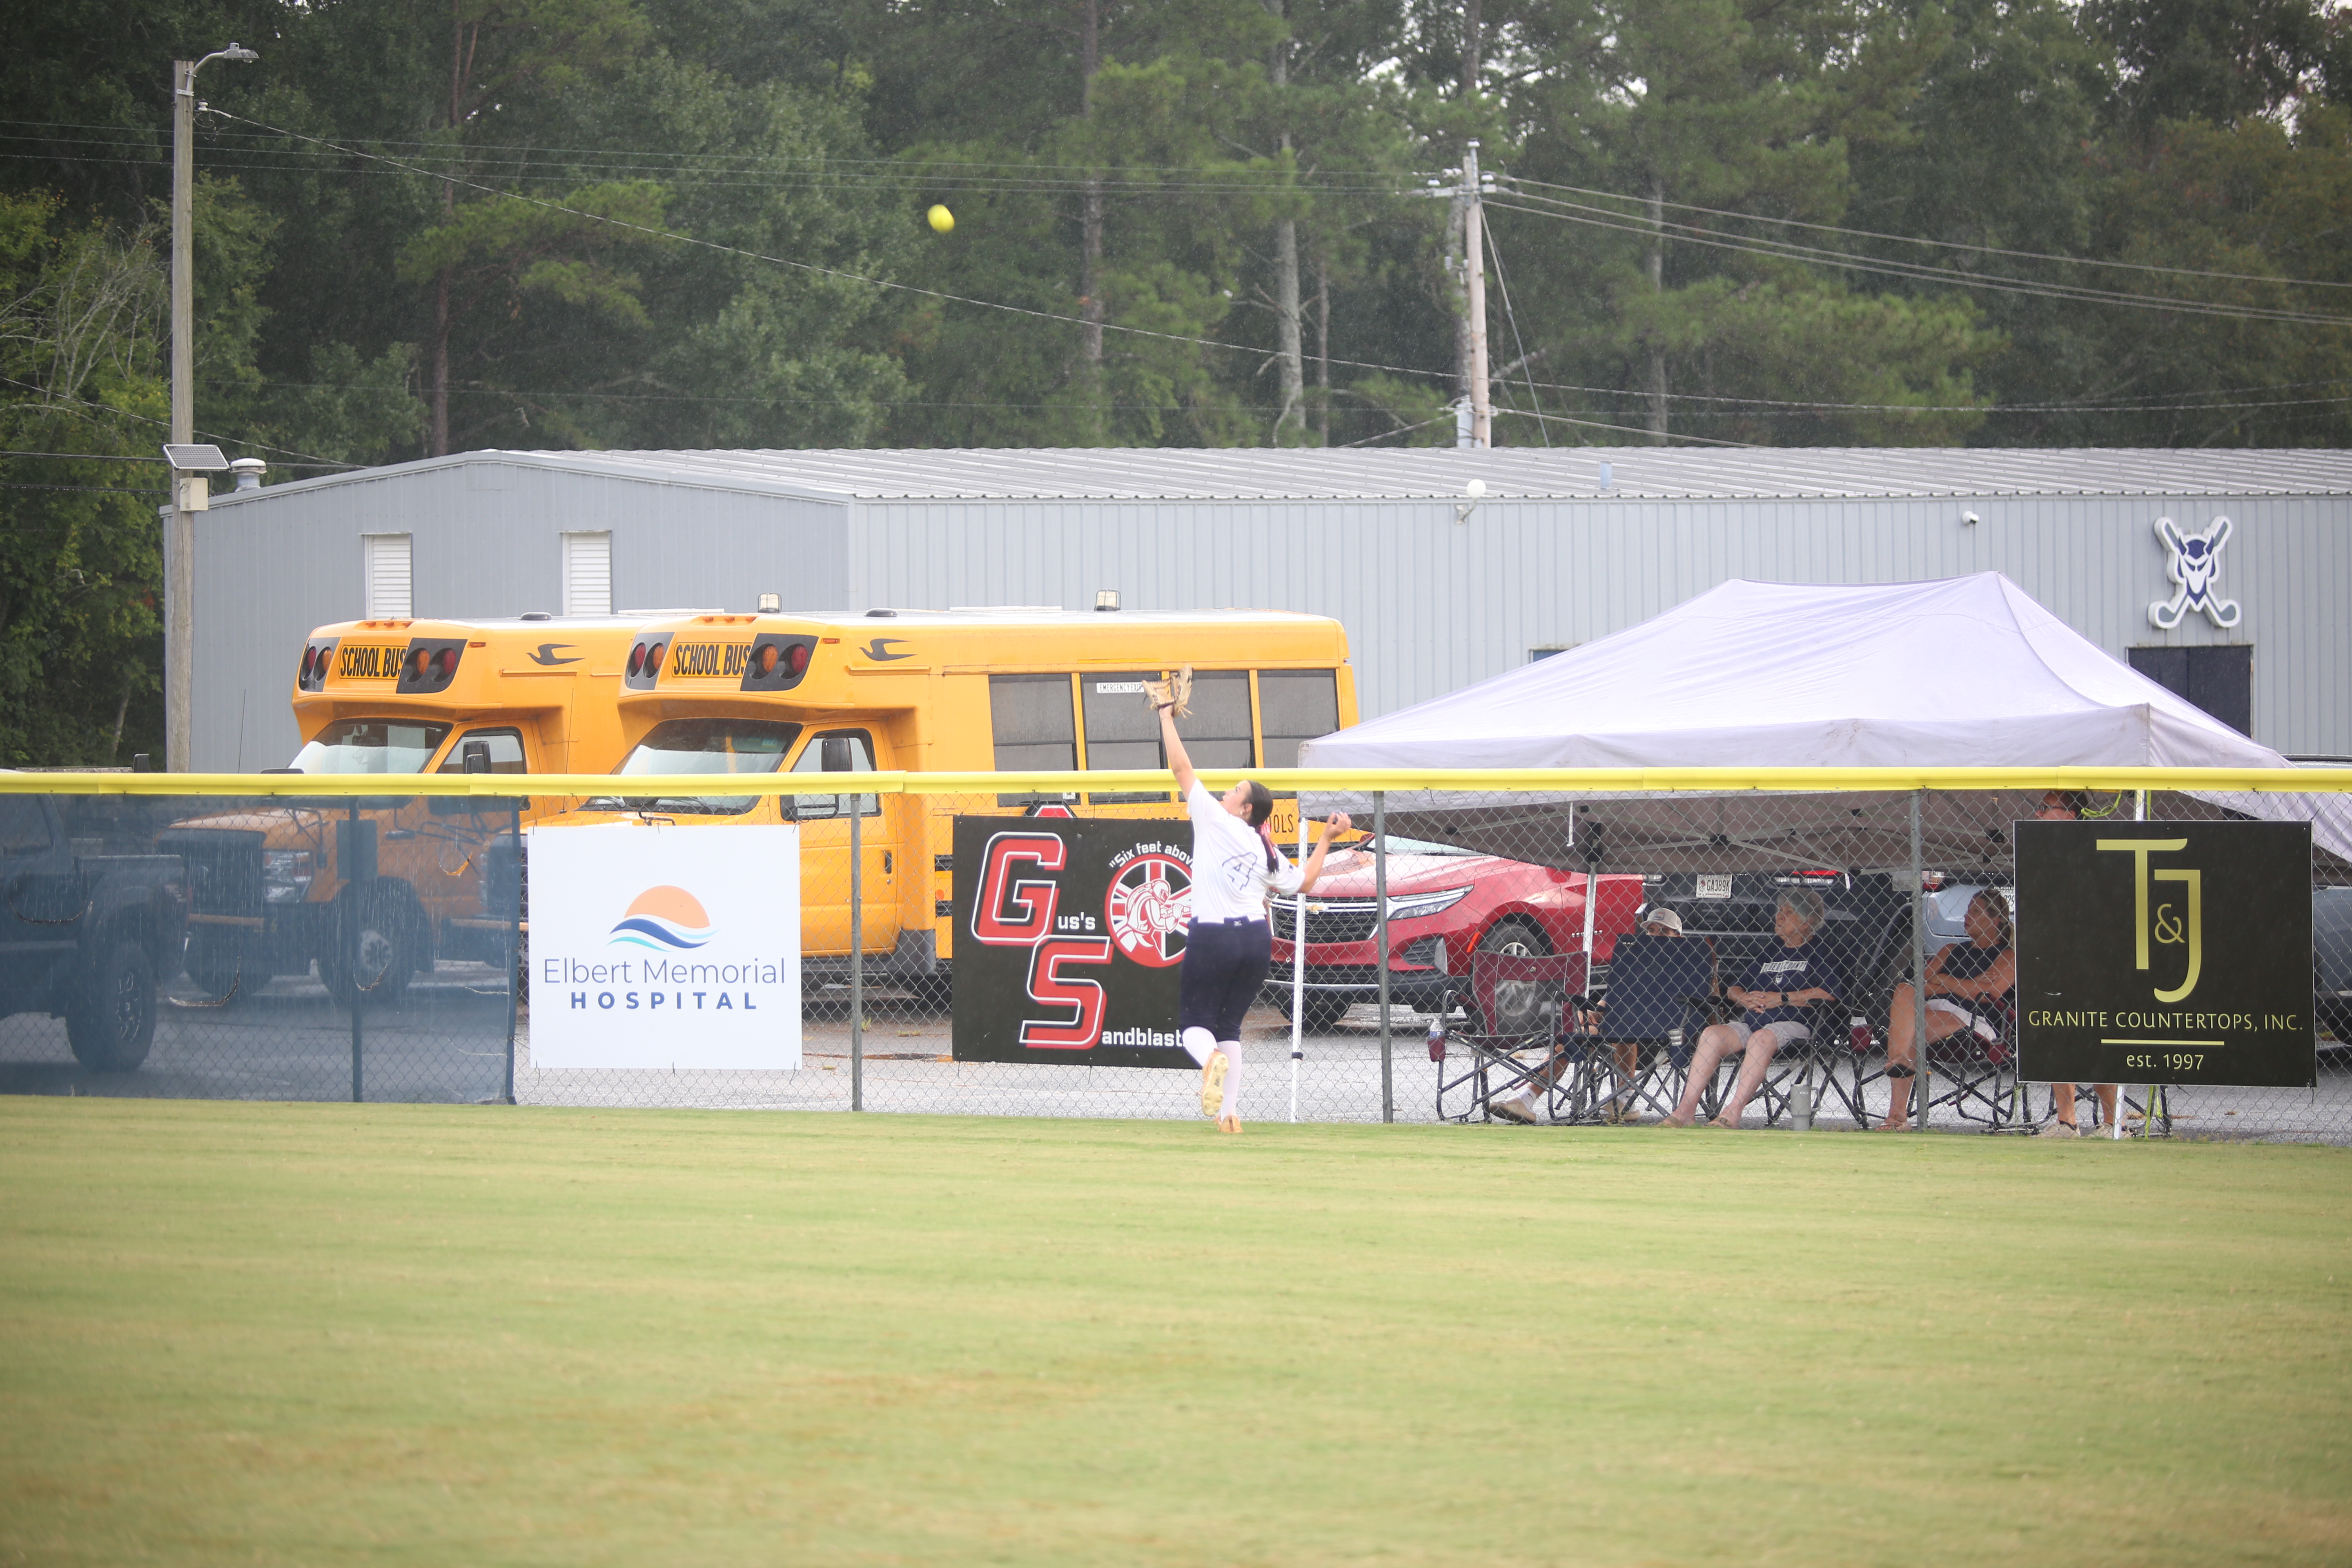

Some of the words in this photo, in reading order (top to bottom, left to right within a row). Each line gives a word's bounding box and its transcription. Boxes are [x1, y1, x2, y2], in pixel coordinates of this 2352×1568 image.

[340, 647, 380, 677] SCHOOL
[382, 648, 408, 677] BUS
[674, 644, 720, 675] SCHOOL
[723, 644, 751, 675] BUS
[1100, 683, 1130, 692] EMERGENCY
[1130, 683, 1142, 691] EXIT
[1136, 840, 1162, 855] feet
[1165, 844, 1194, 868] abov
[1706, 879, 1730, 891] GA389K
[545, 957, 632, 983] Elbert
[644, 957, 784, 984] Memorial
[571, 991, 757, 1009] HOSPITAL
[1019, 934, 1186, 1050] Sandblast
[2029, 1011, 2107, 1027] GRANITE
[2115, 1012, 2257, 1032] COUNTERTOPS,
[2264, 1014, 2303, 1030] INC.
[2126, 1054, 2156, 1067] est.
[2163, 1054, 2204, 1070] 1997
